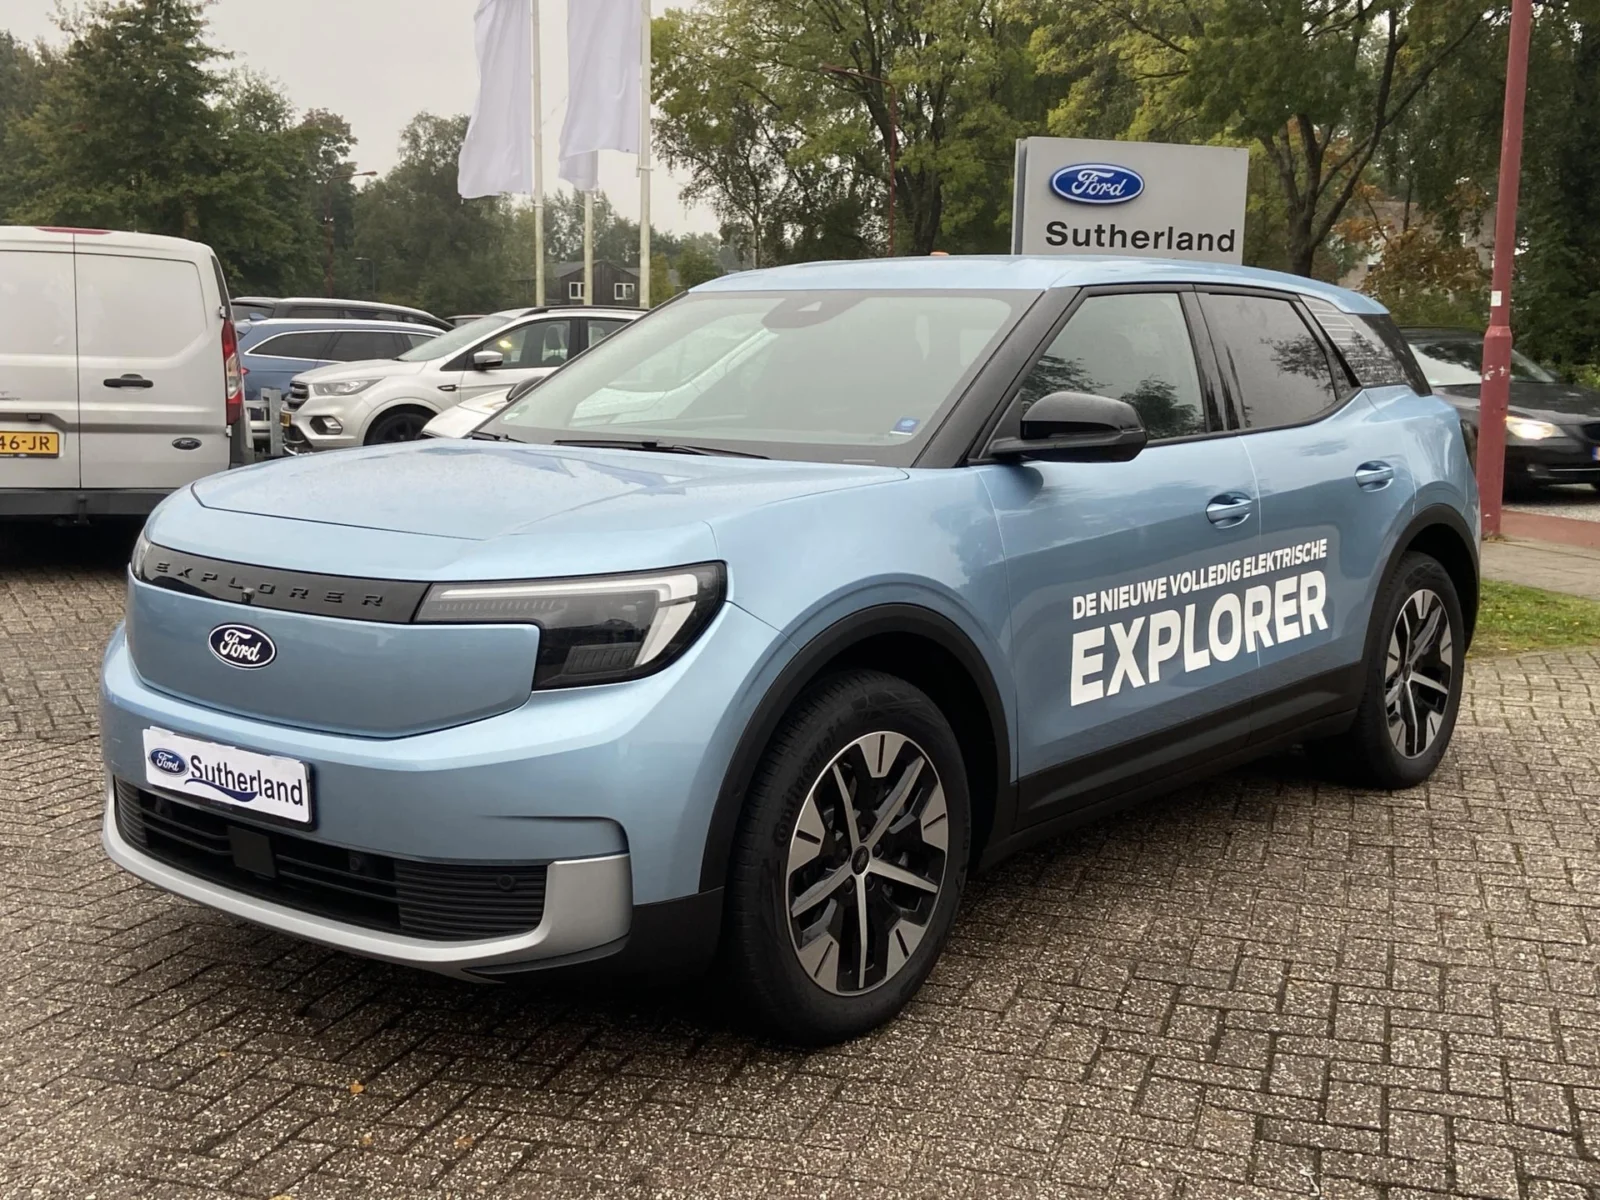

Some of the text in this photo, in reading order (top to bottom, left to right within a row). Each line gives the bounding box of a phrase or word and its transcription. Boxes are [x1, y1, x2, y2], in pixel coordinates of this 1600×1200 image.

[1071, 169, 1127, 196] Ford
[1045, 220, 1235, 253] Sutherland
[155, 562, 384, 607] EXPLORER
[1072, 538, 1327, 620] DE NIEUWE VOLLEDIG ELEKTRISCHE
[219, 628, 262, 662] Ford
[1071, 570, 1329, 706] EXPLORER
[156, 751, 304, 806] Ford Sutherland
